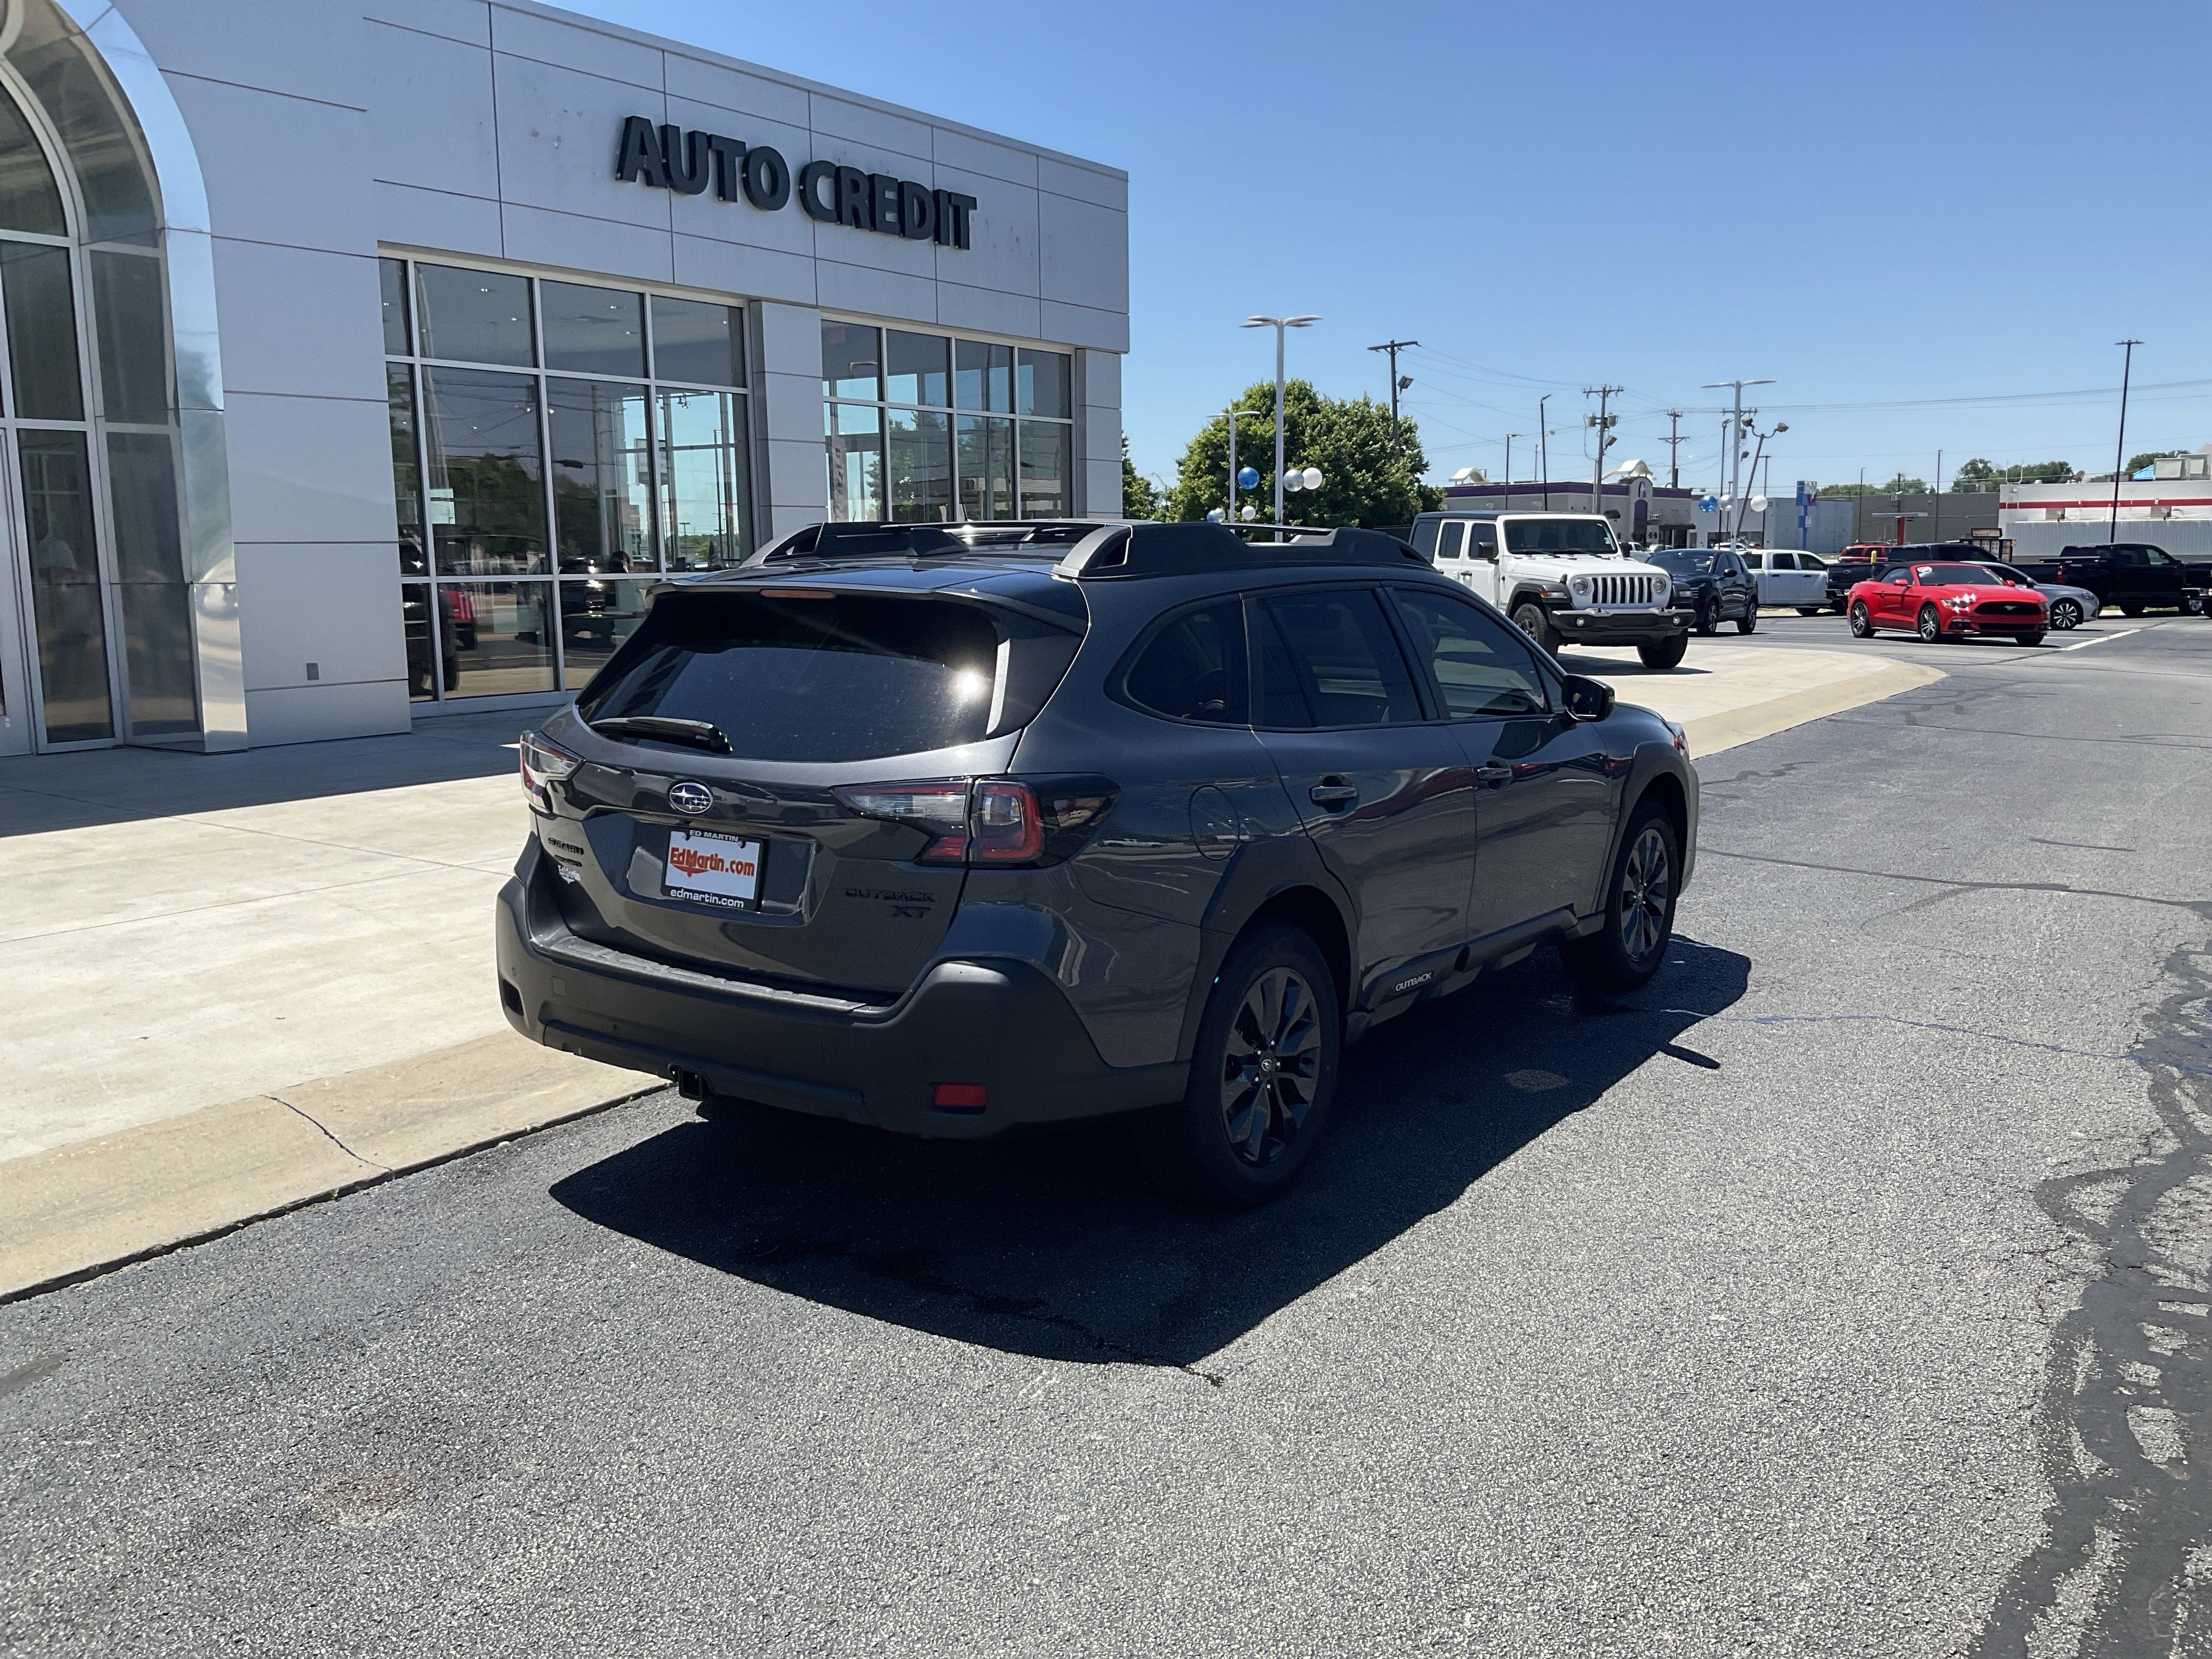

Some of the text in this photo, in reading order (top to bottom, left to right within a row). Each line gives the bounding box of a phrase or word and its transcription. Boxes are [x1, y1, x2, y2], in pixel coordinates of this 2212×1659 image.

[615, 115, 977, 251] AUTO CREDIT
[703, 832, 738, 842] MARTIN
[670, 888, 744, 909] edmartin.com
[845, 888, 936, 902] OUTBACK
[893, 905, 931, 918] XT
[1395, 971, 1432, 992] OUTBACK
